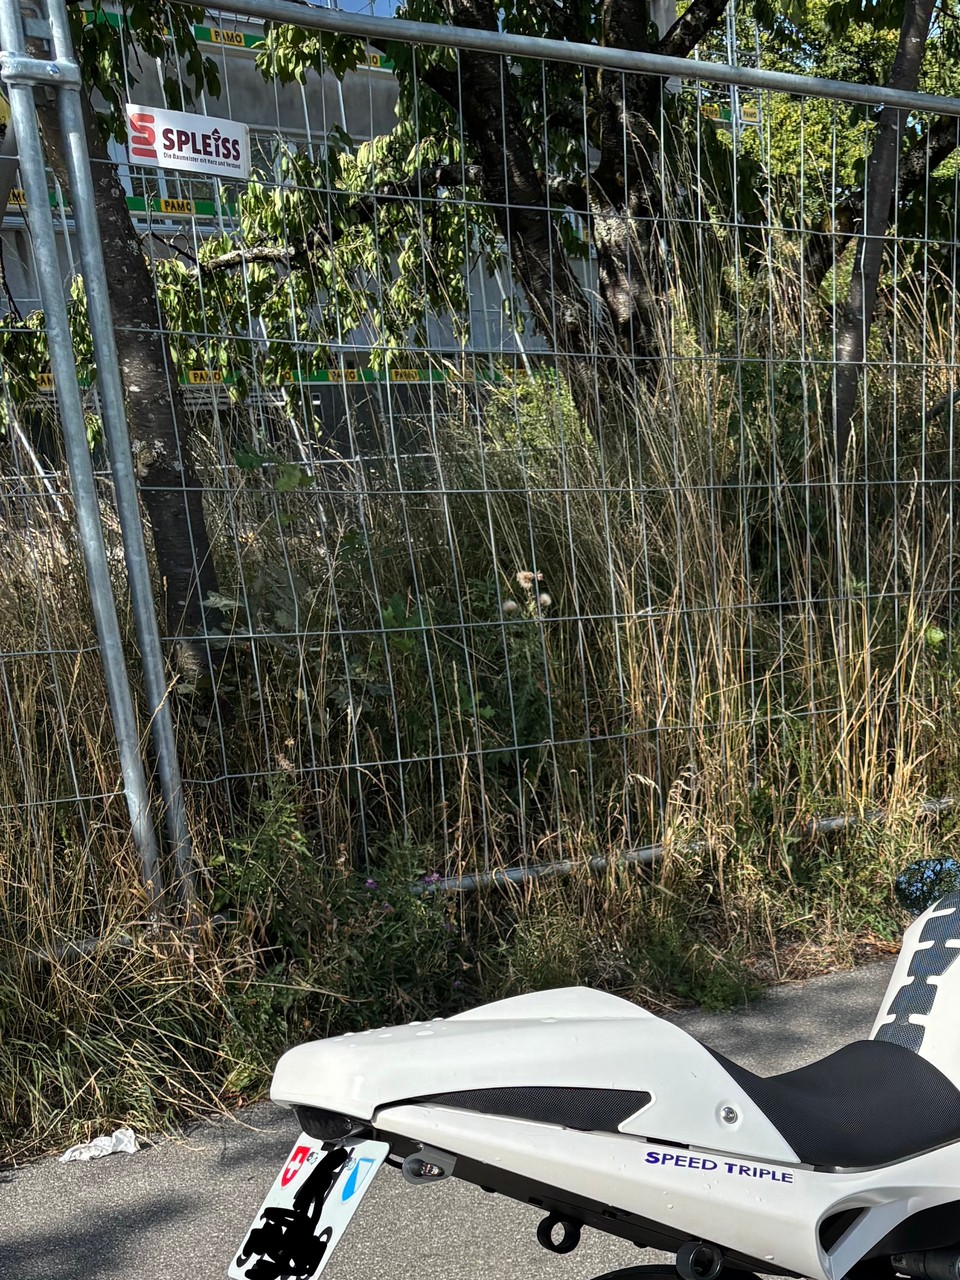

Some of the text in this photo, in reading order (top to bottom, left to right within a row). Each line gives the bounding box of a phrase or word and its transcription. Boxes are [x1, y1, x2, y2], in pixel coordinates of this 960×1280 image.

[214, 30, 242, 44] PAMO
[164, 200, 192, 213] PAMO
[644, 1151, 794, 1184] SPEED TRIPLE
